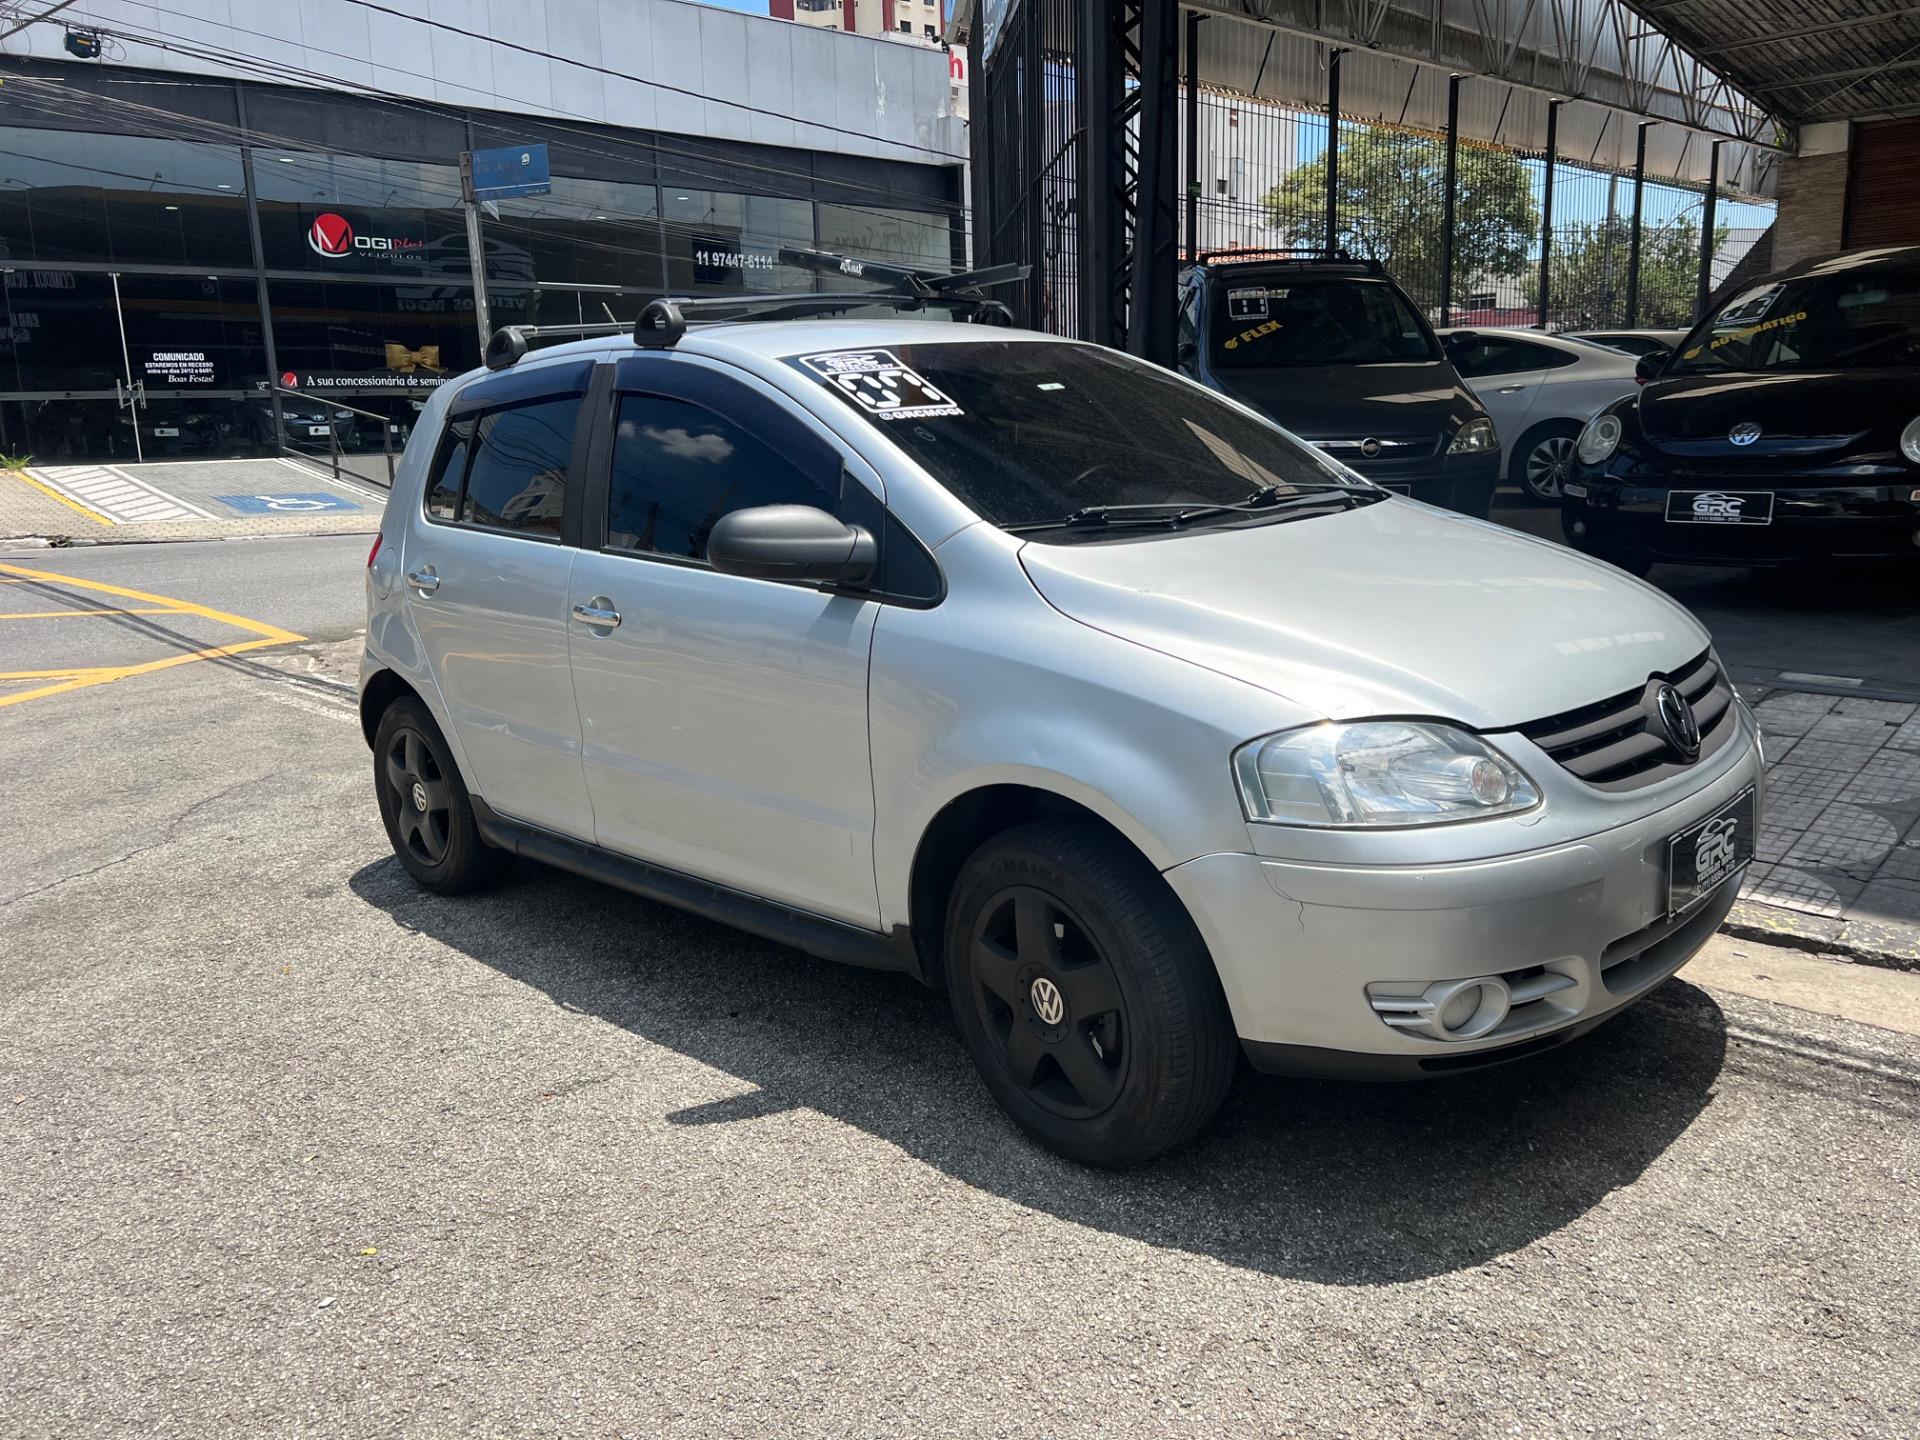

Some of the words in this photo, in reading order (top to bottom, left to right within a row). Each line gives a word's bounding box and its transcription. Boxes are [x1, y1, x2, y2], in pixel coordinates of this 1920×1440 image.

[696, 250, 709, 266] 11
[712, 252, 773, 270] 97447-6114
[1240, 319, 1284, 343] FLEX
[153, 352, 205, 361] COMUNICADO
[168, 374, 187, 383] Boas
[189, 374, 215, 383] Festas!
[306, 375, 315, 386] A
[317, 378, 334, 386] sua
[336, 376, 405, 386] concessionária
[407, 375, 418, 386] de
[1693, 500, 1741, 513] GRC
[1695, 824, 1735, 872] GRC
